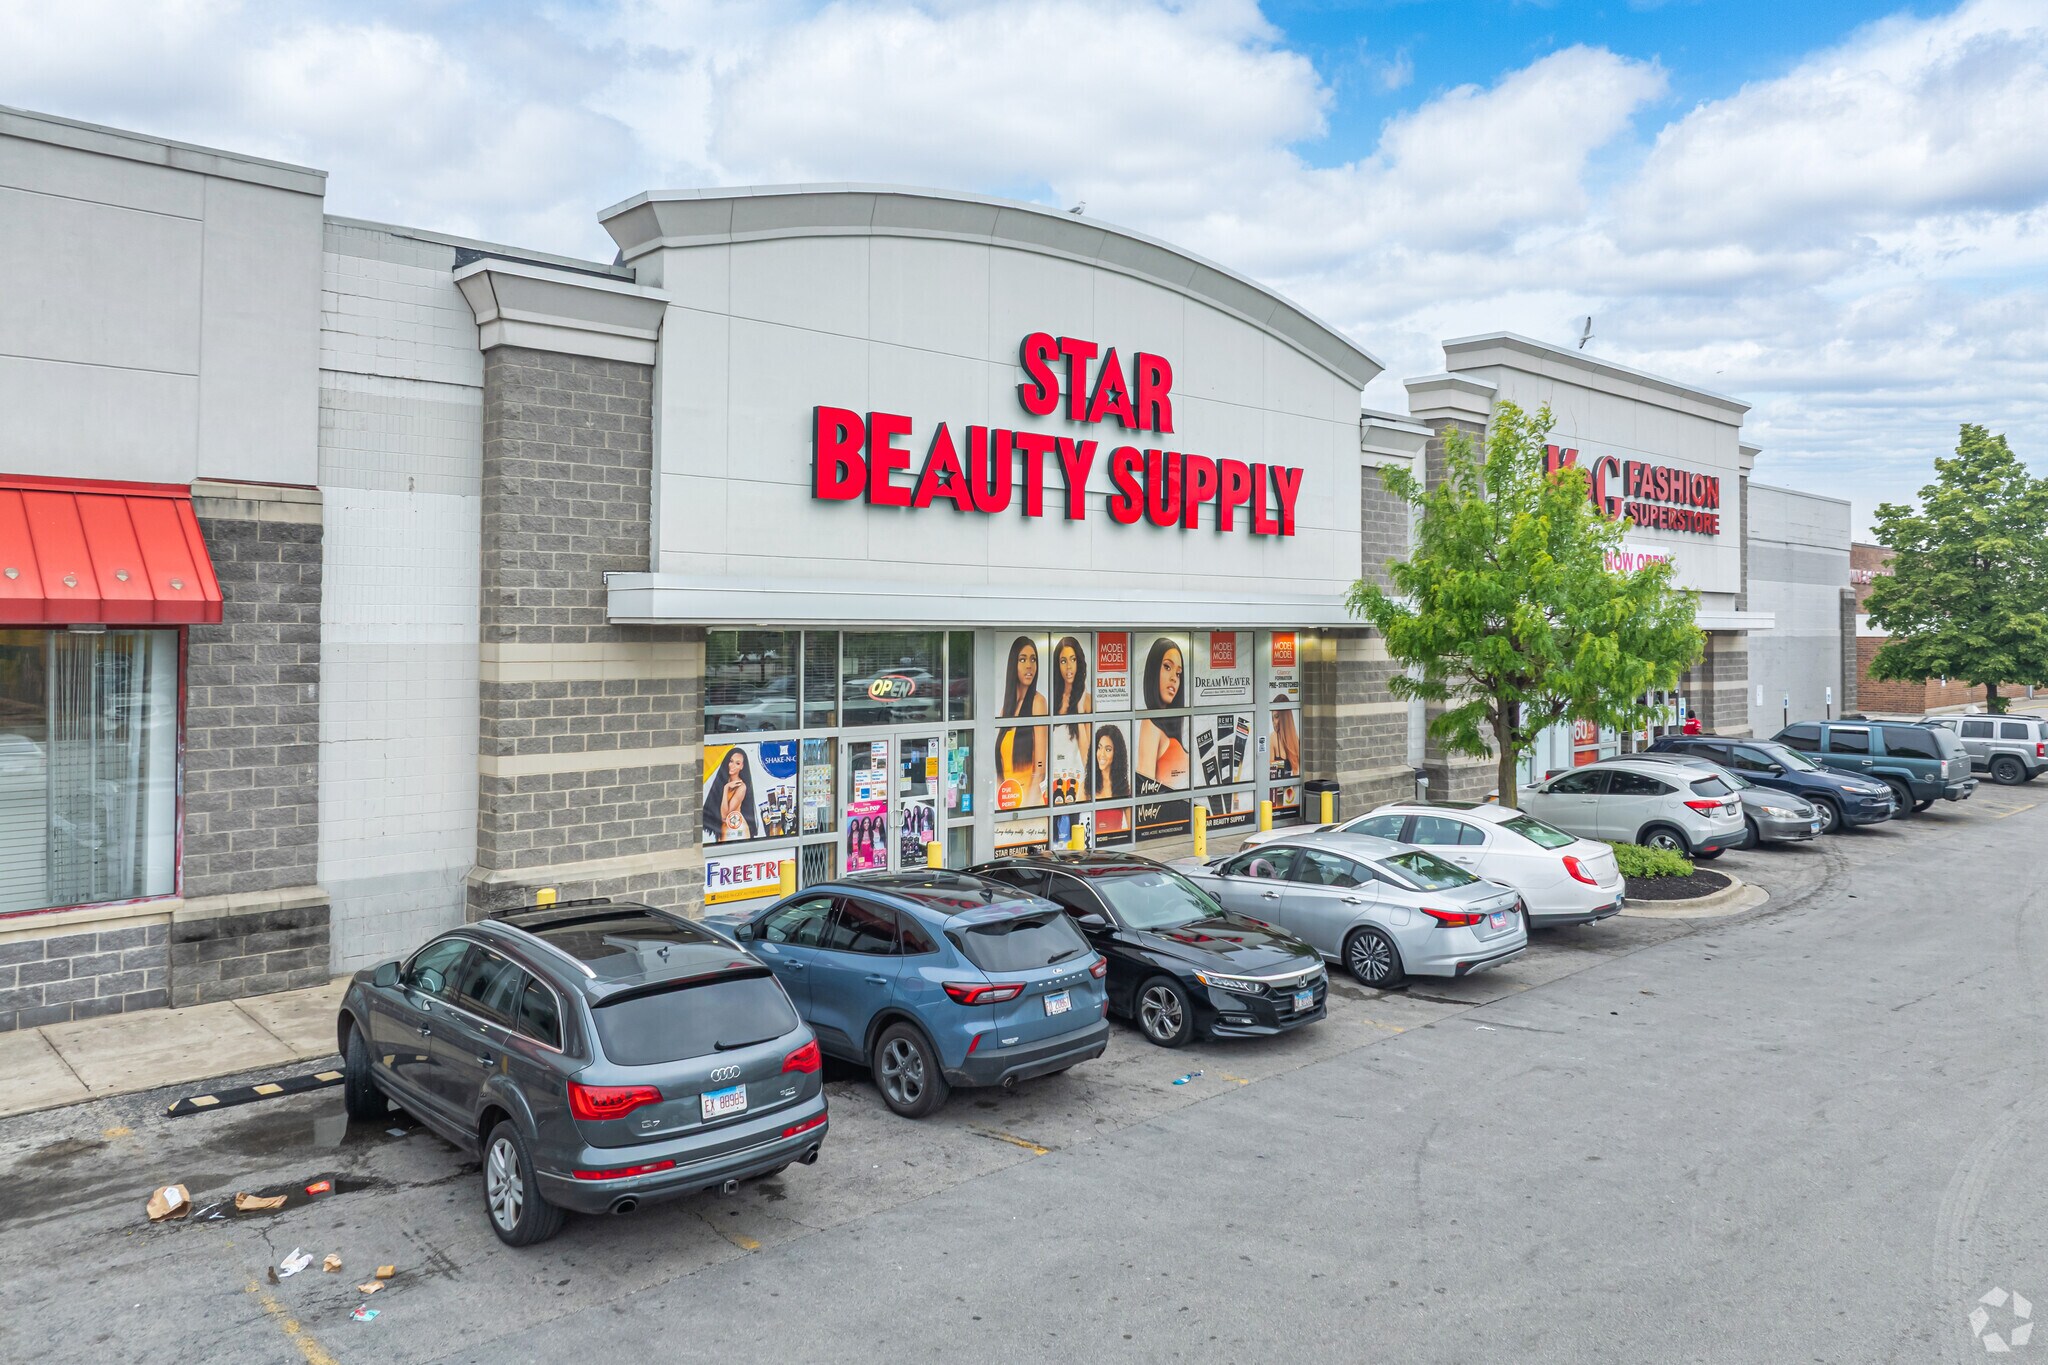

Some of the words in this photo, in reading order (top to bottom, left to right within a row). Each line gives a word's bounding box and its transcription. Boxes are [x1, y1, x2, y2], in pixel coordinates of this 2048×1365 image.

[1017, 332, 1174, 434] STAR
[812, 405, 1098, 521] BEAUTY
[1106, 446, 1304, 537] SUPPLY
[1623, 460, 1720, 509] FASHION
[1625, 501, 1720, 535] SUPERSTORE
[1100, 643, 1124, 653] MODEL
[1212, 642, 1233, 651] MODEL
[1274, 641, 1292, 650] MODEL
[1100, 653, 1124, 663] MODEL
[1212, 651, 1233, 660] MODEL
[1274, 650, 1292, 659] MODEL
[871, 679, 910, 697] OPEN
[1096, 677, 1126, 688] HAUTE
[1141, 779, 1162, 794] Model
[1138, 803, 1161, 822] Model
[1213, 817, 1229, 825] BEAUTY
[1230, 815, 1246, 823] SUPPLY
[995, 849, 1008, 858] STAR
[1009, 846, 1028, 856] BEAUTY
[707, 859, 795, 887] FREETR
[705, 1099, 714, 1113] EX
